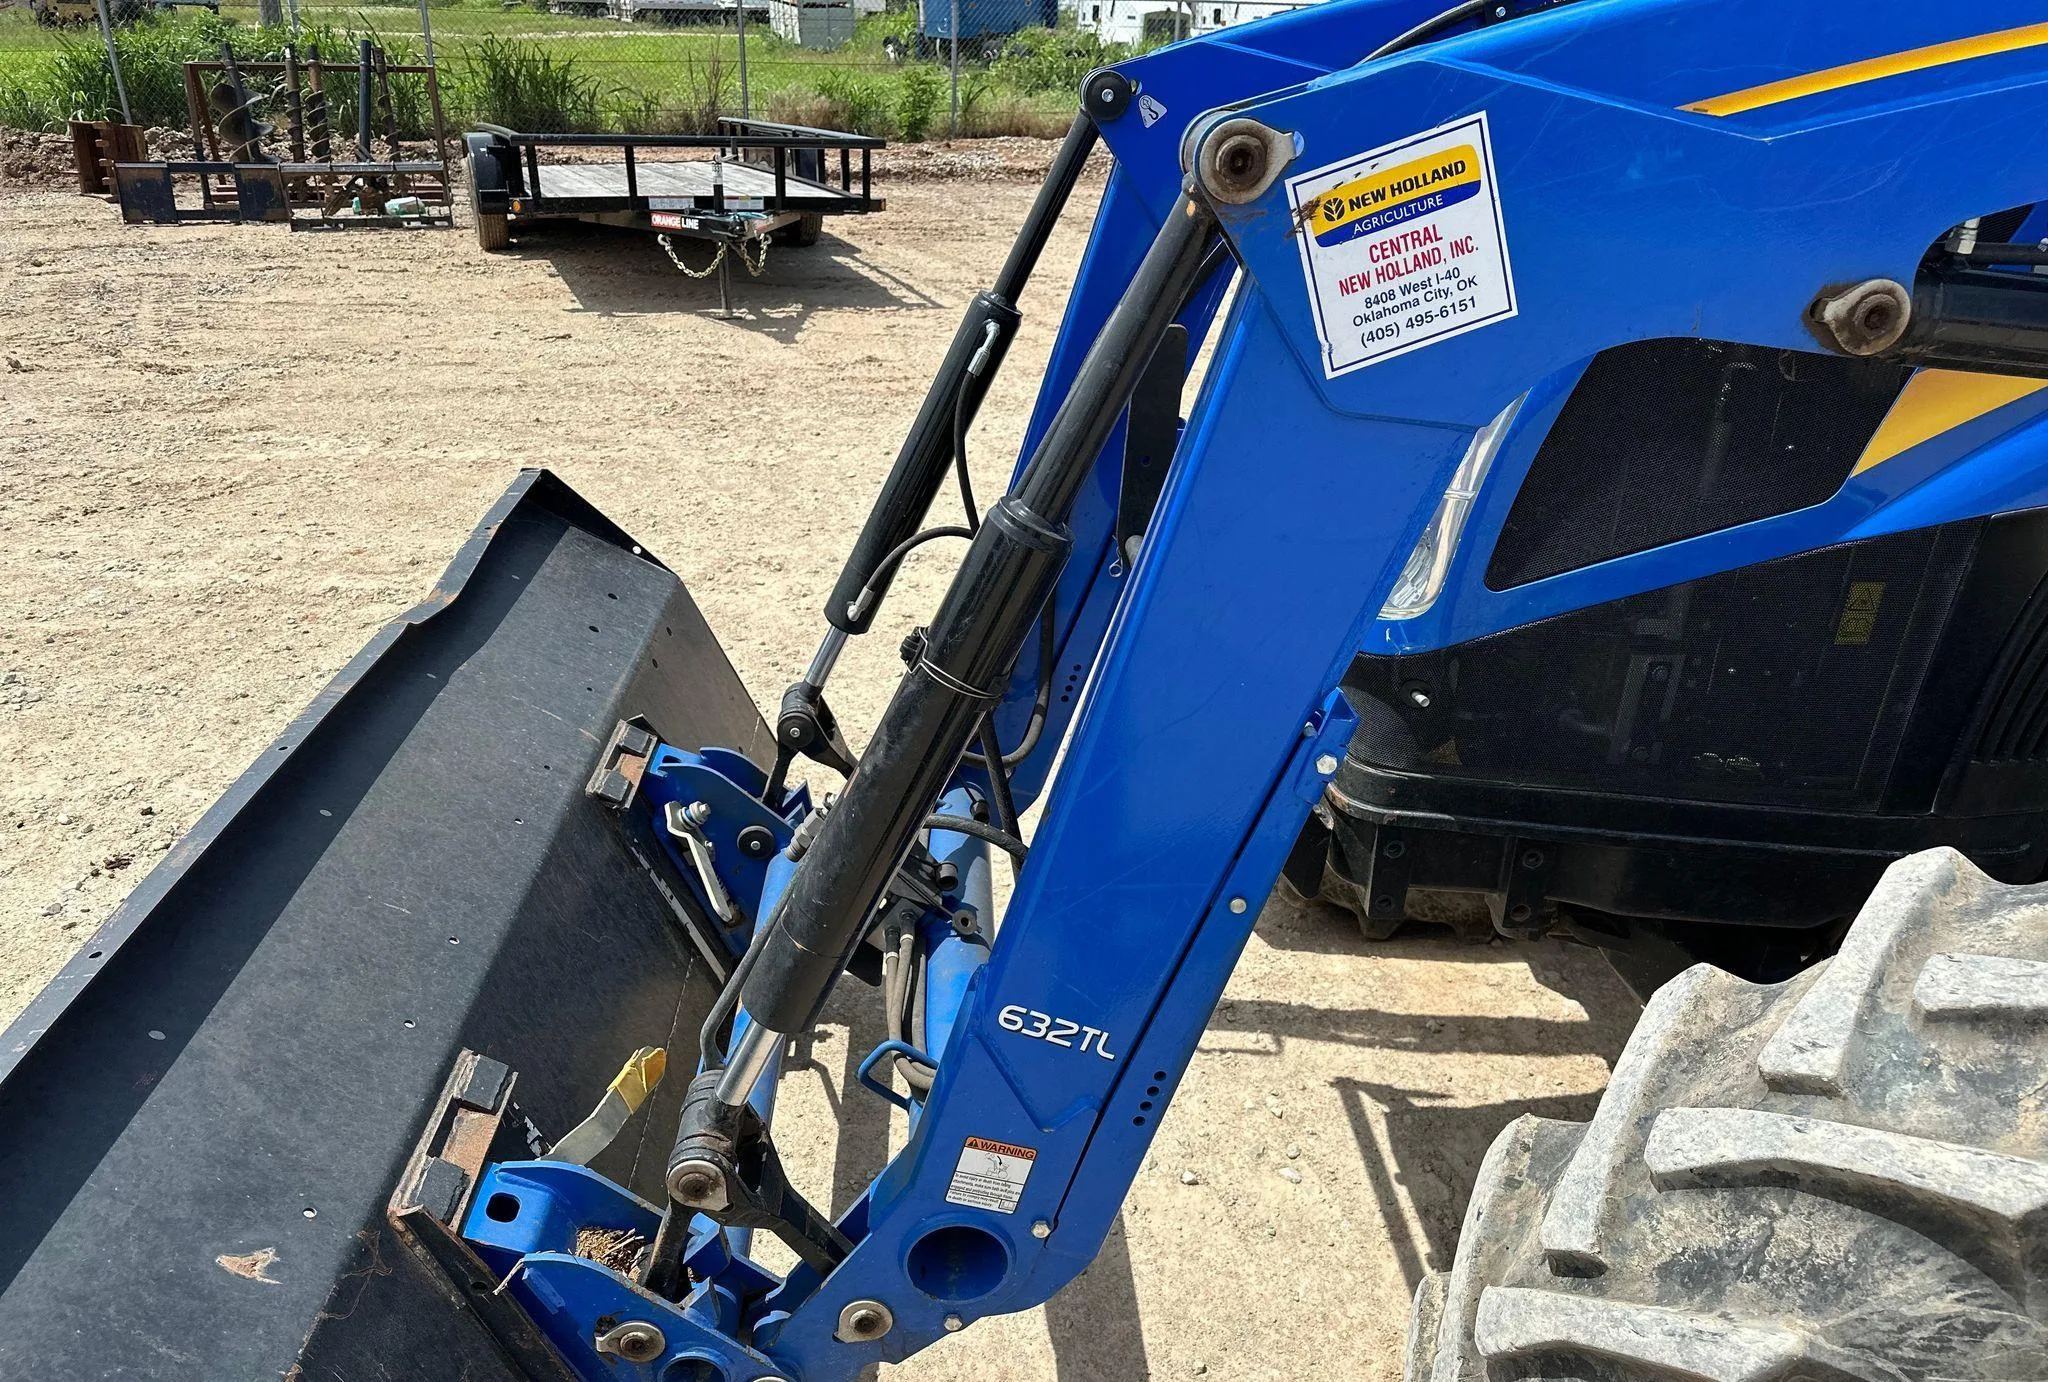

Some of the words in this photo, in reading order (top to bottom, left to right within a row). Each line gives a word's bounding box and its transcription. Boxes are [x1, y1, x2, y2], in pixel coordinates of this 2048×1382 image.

[1348, 187, 1386, 212] NEW
[1390, 159, 1466, 197] HOLLAND
[651, 214, 681, 227] ORANGE
[681, 217, 699, 230] LINE
[1353, 194, 1444, 235] AGRICULTURE
[1338, 269, 1371, 297] NEW
[1376, 247, 1447, 286] HOLLAND,
[1449, 235, 1479, 260] INC.
[1369, 223, 1444, 264] CENTRAL
[1352, 297, 1421, 328] Oklahoma
[1424, 285, 1453, 305] City,
[1457, 276, 1478, 293] OK
[1364, 289, 1396, 309] 8408
[1398, 276, 1433, 297] West
[1435, 266, 1461, 285] I-40
[1360, 322, 1401, 348] (405)
[1405, 296, 1477, 331] 495-6151
[998, 1004, 1115, 1060] 632TL
[981, 1141, 1034, 1159] WARNING
